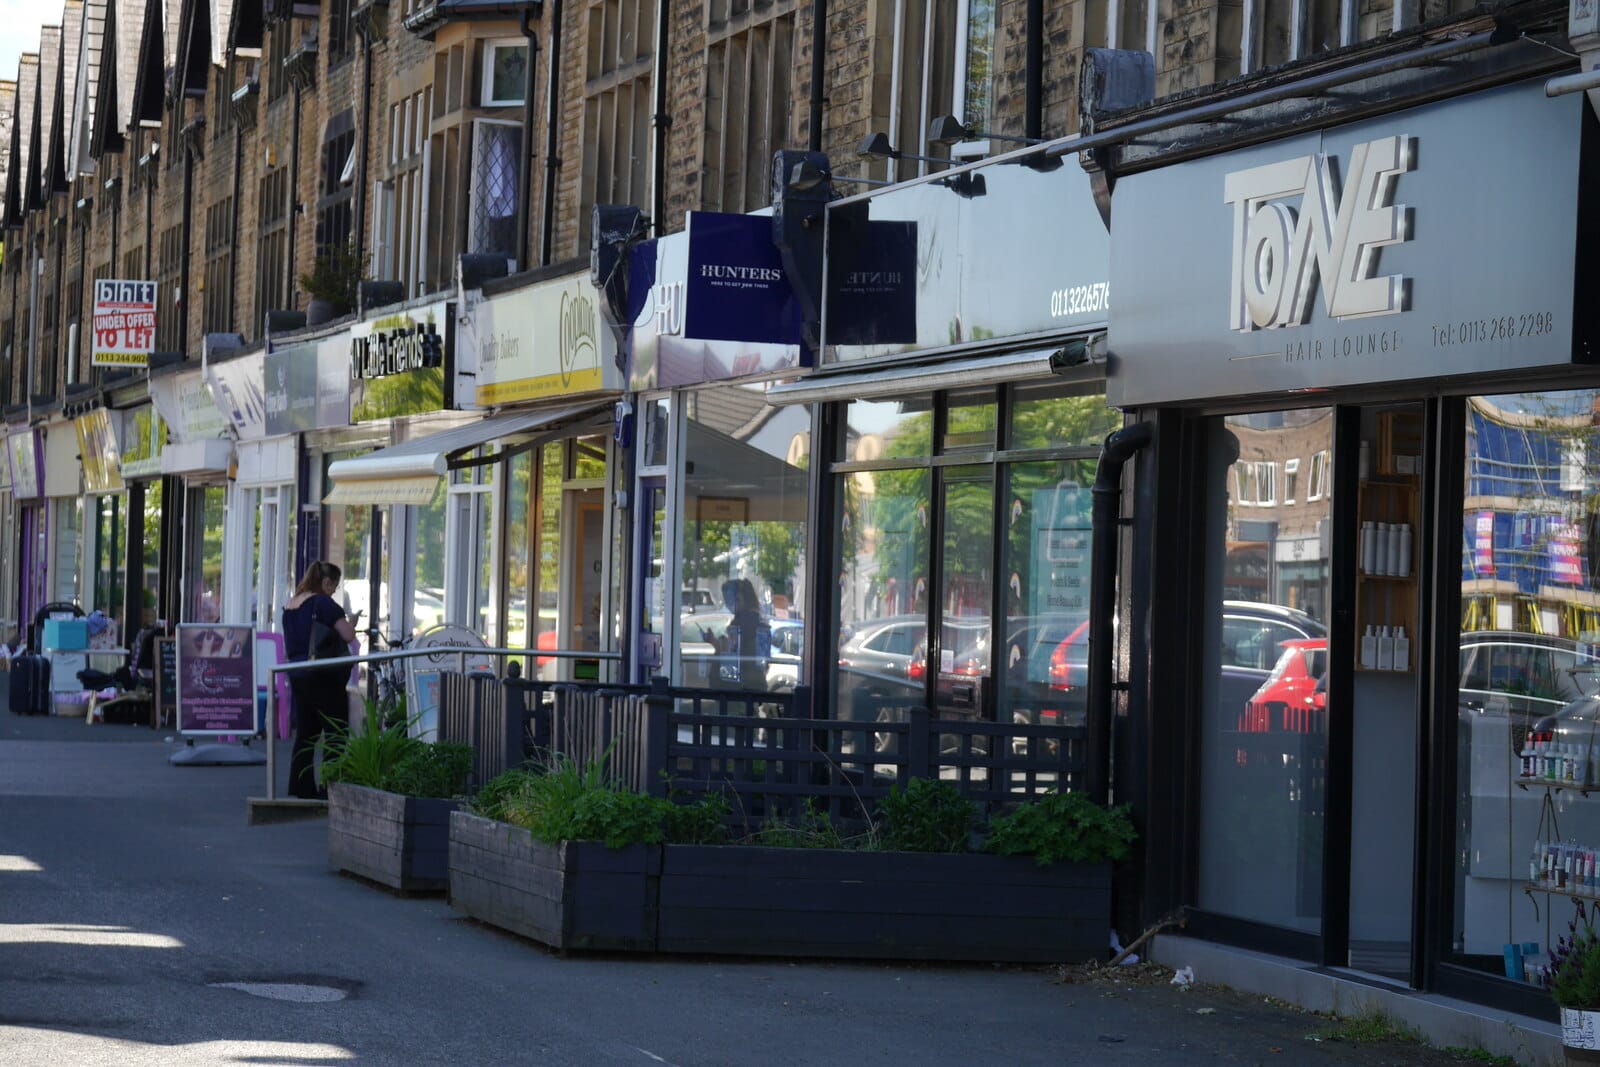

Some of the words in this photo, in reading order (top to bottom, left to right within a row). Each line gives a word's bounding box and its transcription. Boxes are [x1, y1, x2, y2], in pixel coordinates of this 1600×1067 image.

[1224, 134, 1410, 333] TONE
[701, 264, 781, 282] HUNTERS
[96, 315, 125, 329] UNDER
[127, 312, 154, 327] OFFER
[1432, 324, 1455, 347] Tel:
[1459, 319, 1486, 346] 0113
[1491, 315, 1514, 340] 268
[1519, 311, 1553, 337] 2298
[96, 328, 117, 348] TO
[124, 328, 153, 349] LET
[1285, 339, 1322, 362] HAIR
[1333, 330, 1400, 358] LOUNGE
